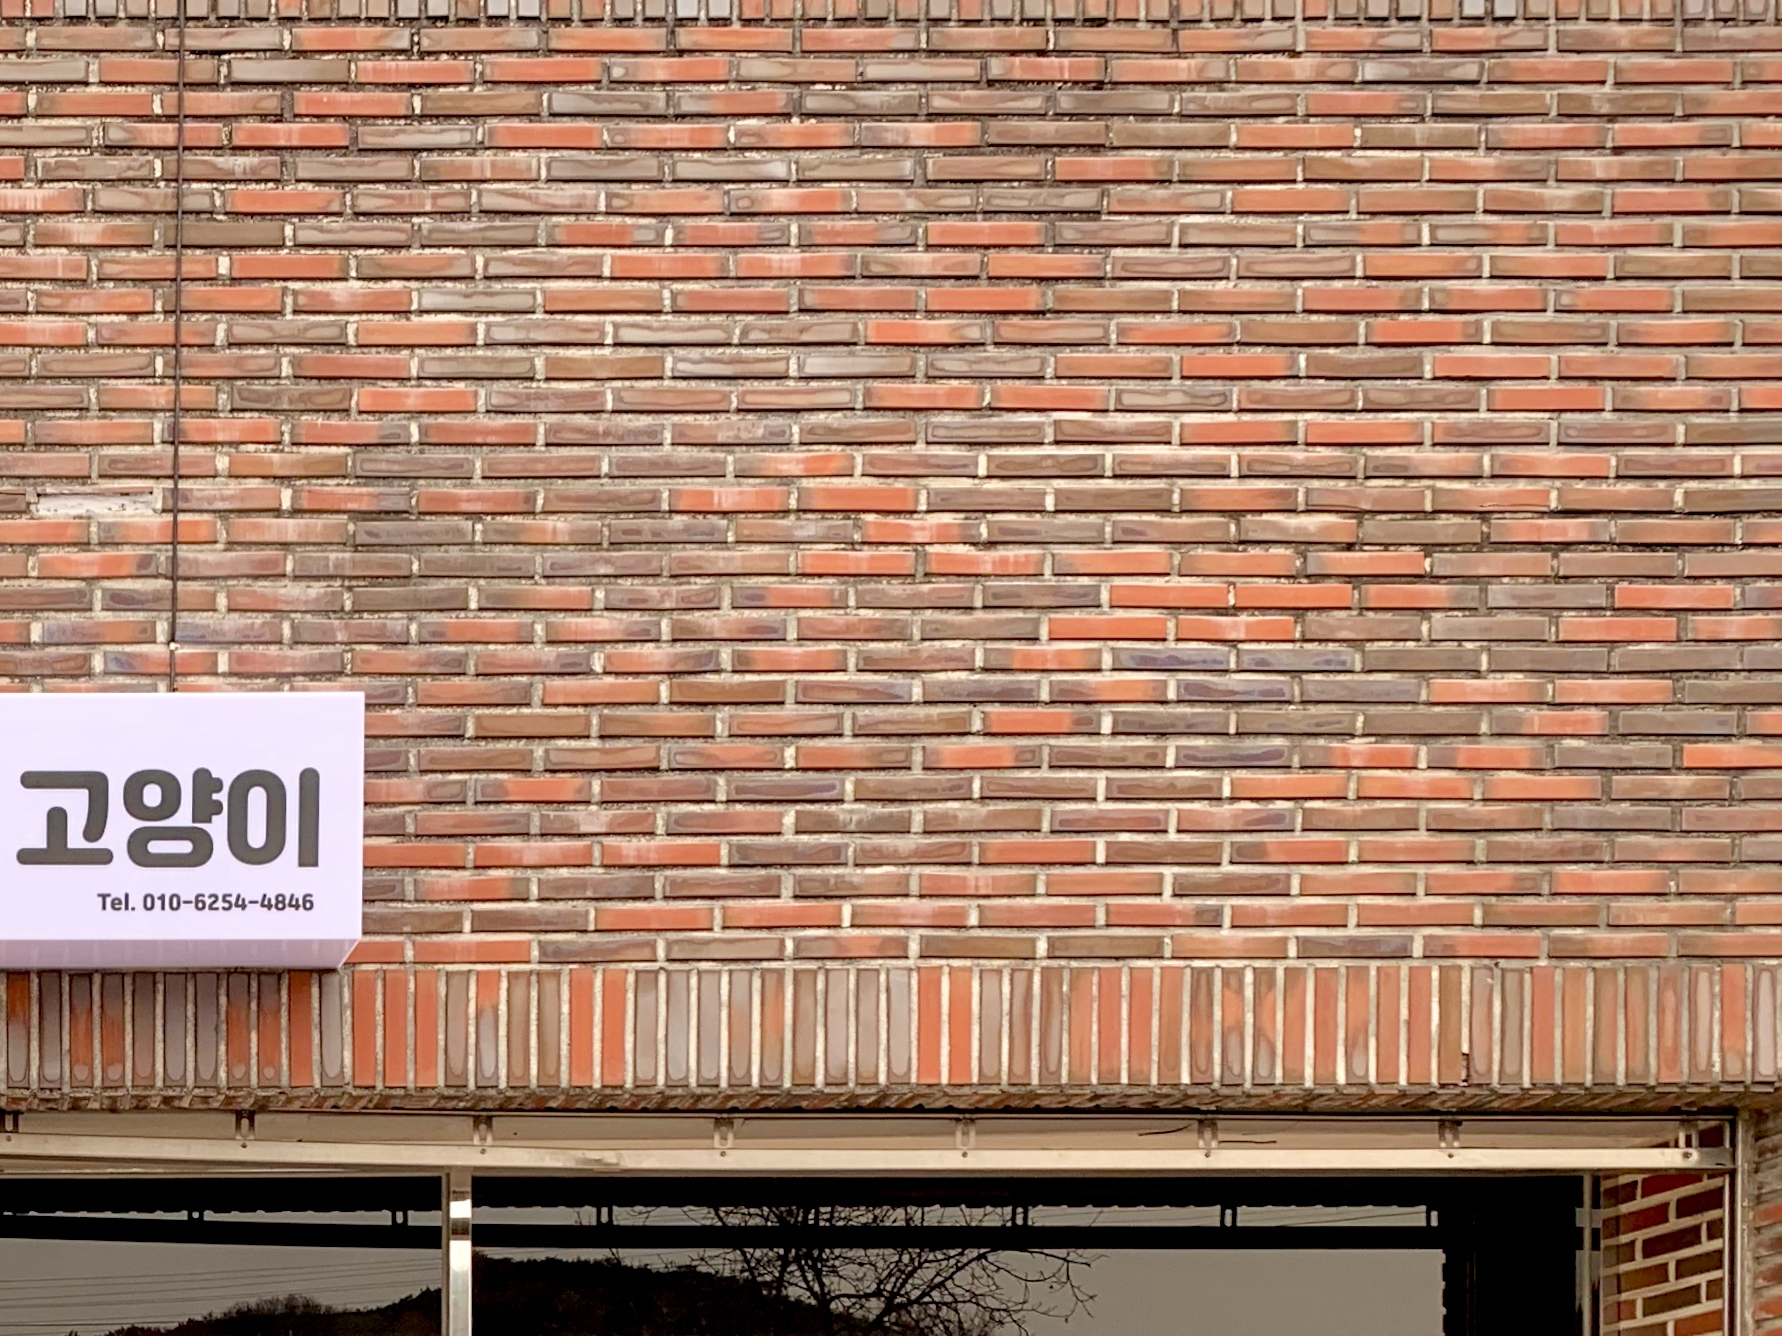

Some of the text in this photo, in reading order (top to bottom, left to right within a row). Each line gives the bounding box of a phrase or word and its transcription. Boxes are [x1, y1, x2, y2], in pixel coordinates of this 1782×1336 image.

[16, 766, 321, 868] 고양이
[97, 892, 316, 913] Tel. 010-6254-4846
